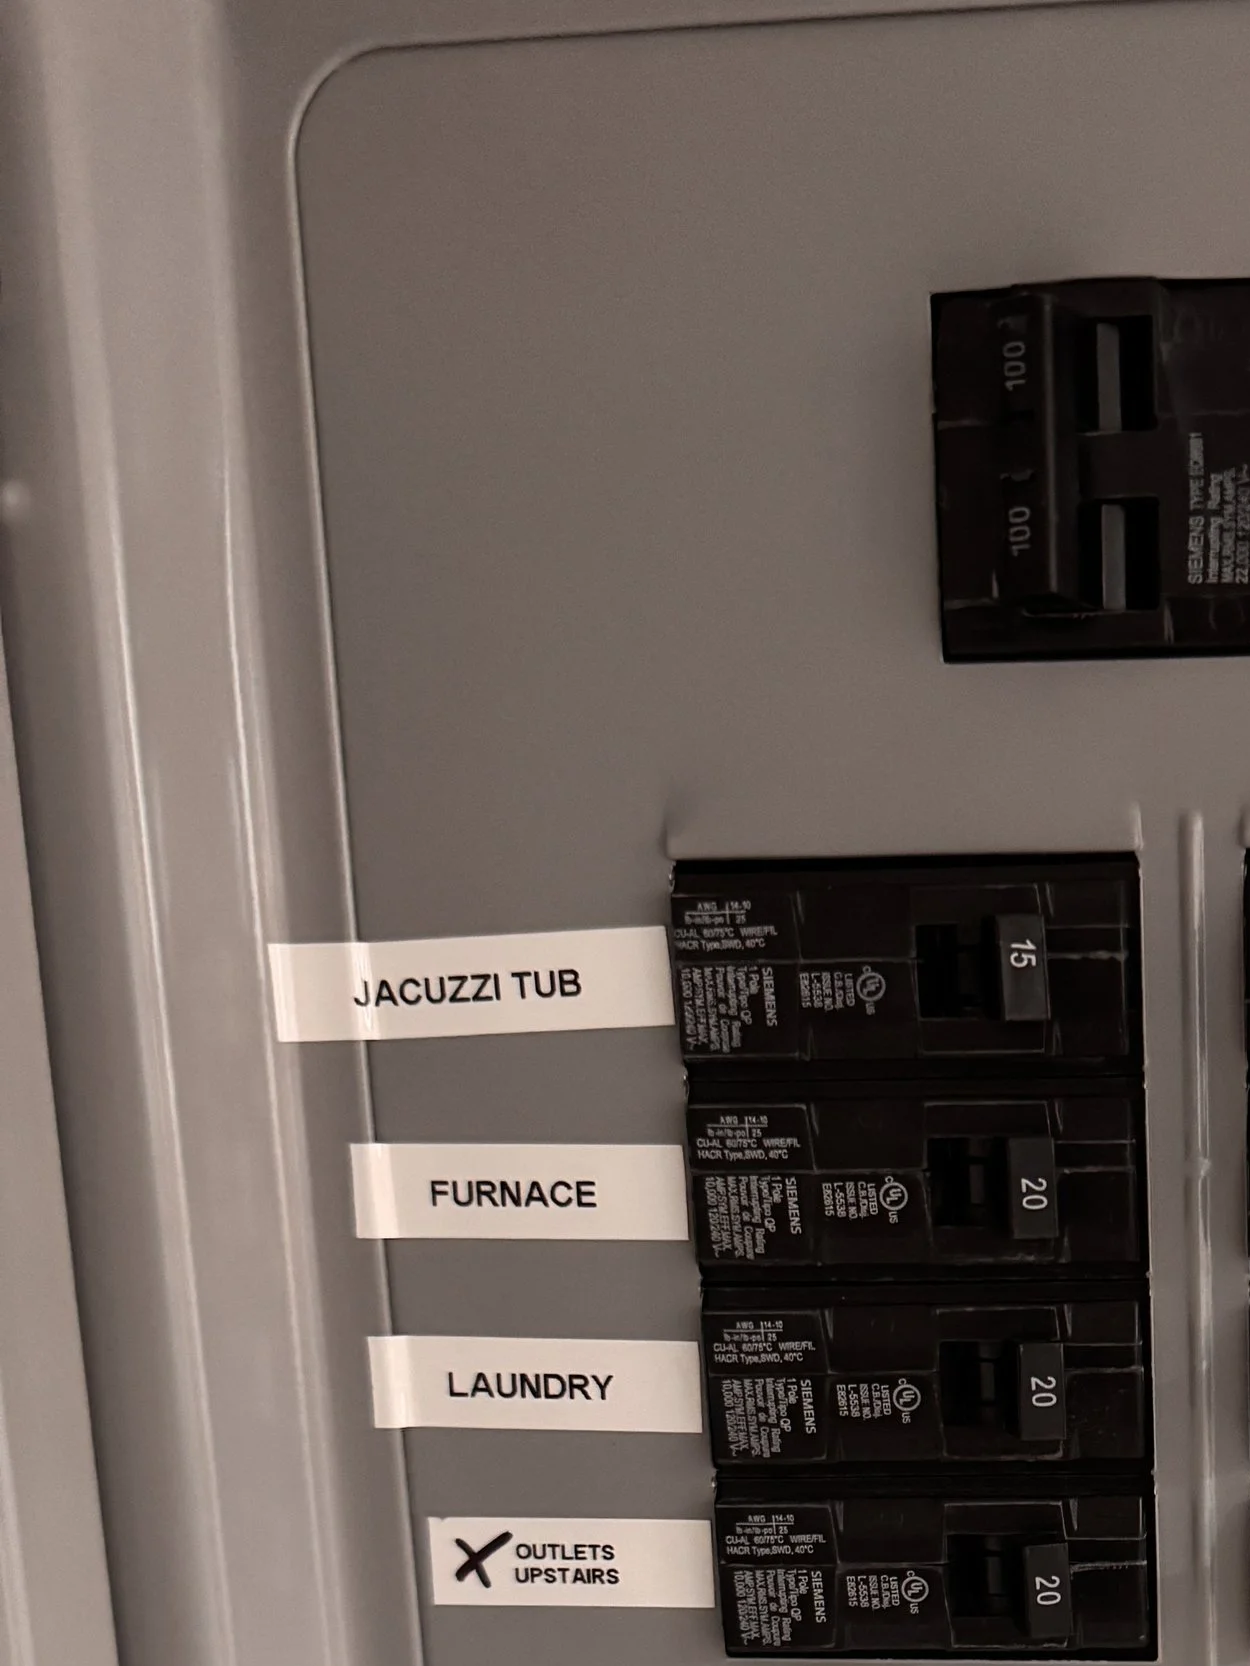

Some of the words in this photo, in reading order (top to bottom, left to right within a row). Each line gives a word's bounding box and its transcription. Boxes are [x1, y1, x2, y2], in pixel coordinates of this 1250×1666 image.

[1002, 341, 1027, 392] 100
[1007, 506, 1032, 557] 100
[1187, 515, 1205, 585] SIEMENS
[1009, 939, 1036, 968] 15
[354, 973, 501, 1007] JACUZZI
[511, 969, 582, 999] TUB
[761, 967, 778, 1027] SIEMENS
[429, 1180, 597, 1207] FURNACE
[785, 1176, 802, 1234] SIEMENS
[1021, 1177, 1048, 1210] 20
[448, 1371, 614, 1401] LAUNDRY
[1030, 1376, 1057, 1407] 20
[800, 1378, 816, 1434] SIEMENS
[515, 1543, 616, 1561] OUTLETS
[515, 1567, 620, 1585] UPSTAIRS
[1035, 1575, 1061, 1605] 20
[811, 1570, 827, 1623] SIEMENS
